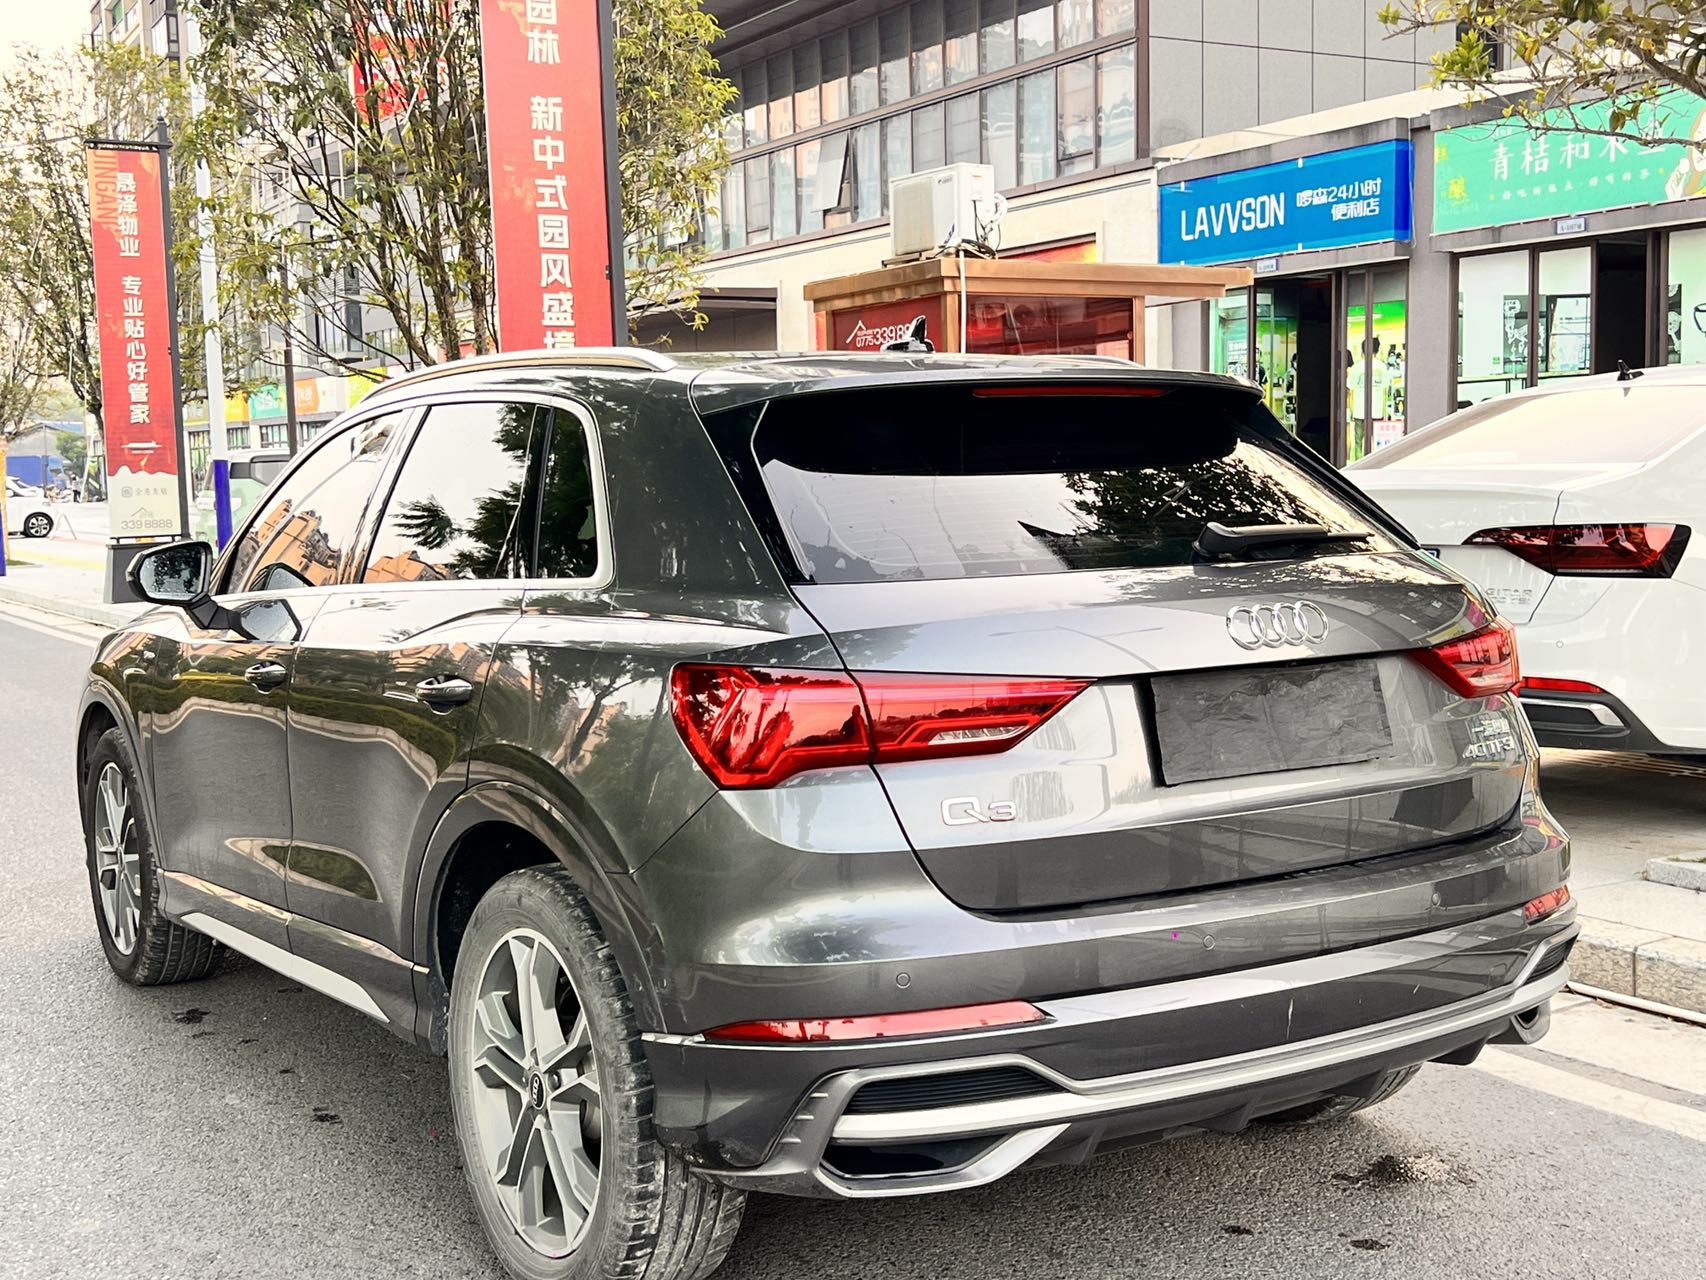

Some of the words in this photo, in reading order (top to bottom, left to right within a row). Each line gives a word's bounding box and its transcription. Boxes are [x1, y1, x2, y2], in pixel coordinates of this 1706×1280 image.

[1181, 191, 1285, 241] LAVVSON
[1331, 198, 1380, 221] 便利店
[121, 274, 150, 424] 专业贴心好管家
[941, 796, 1017, 826] Q3
